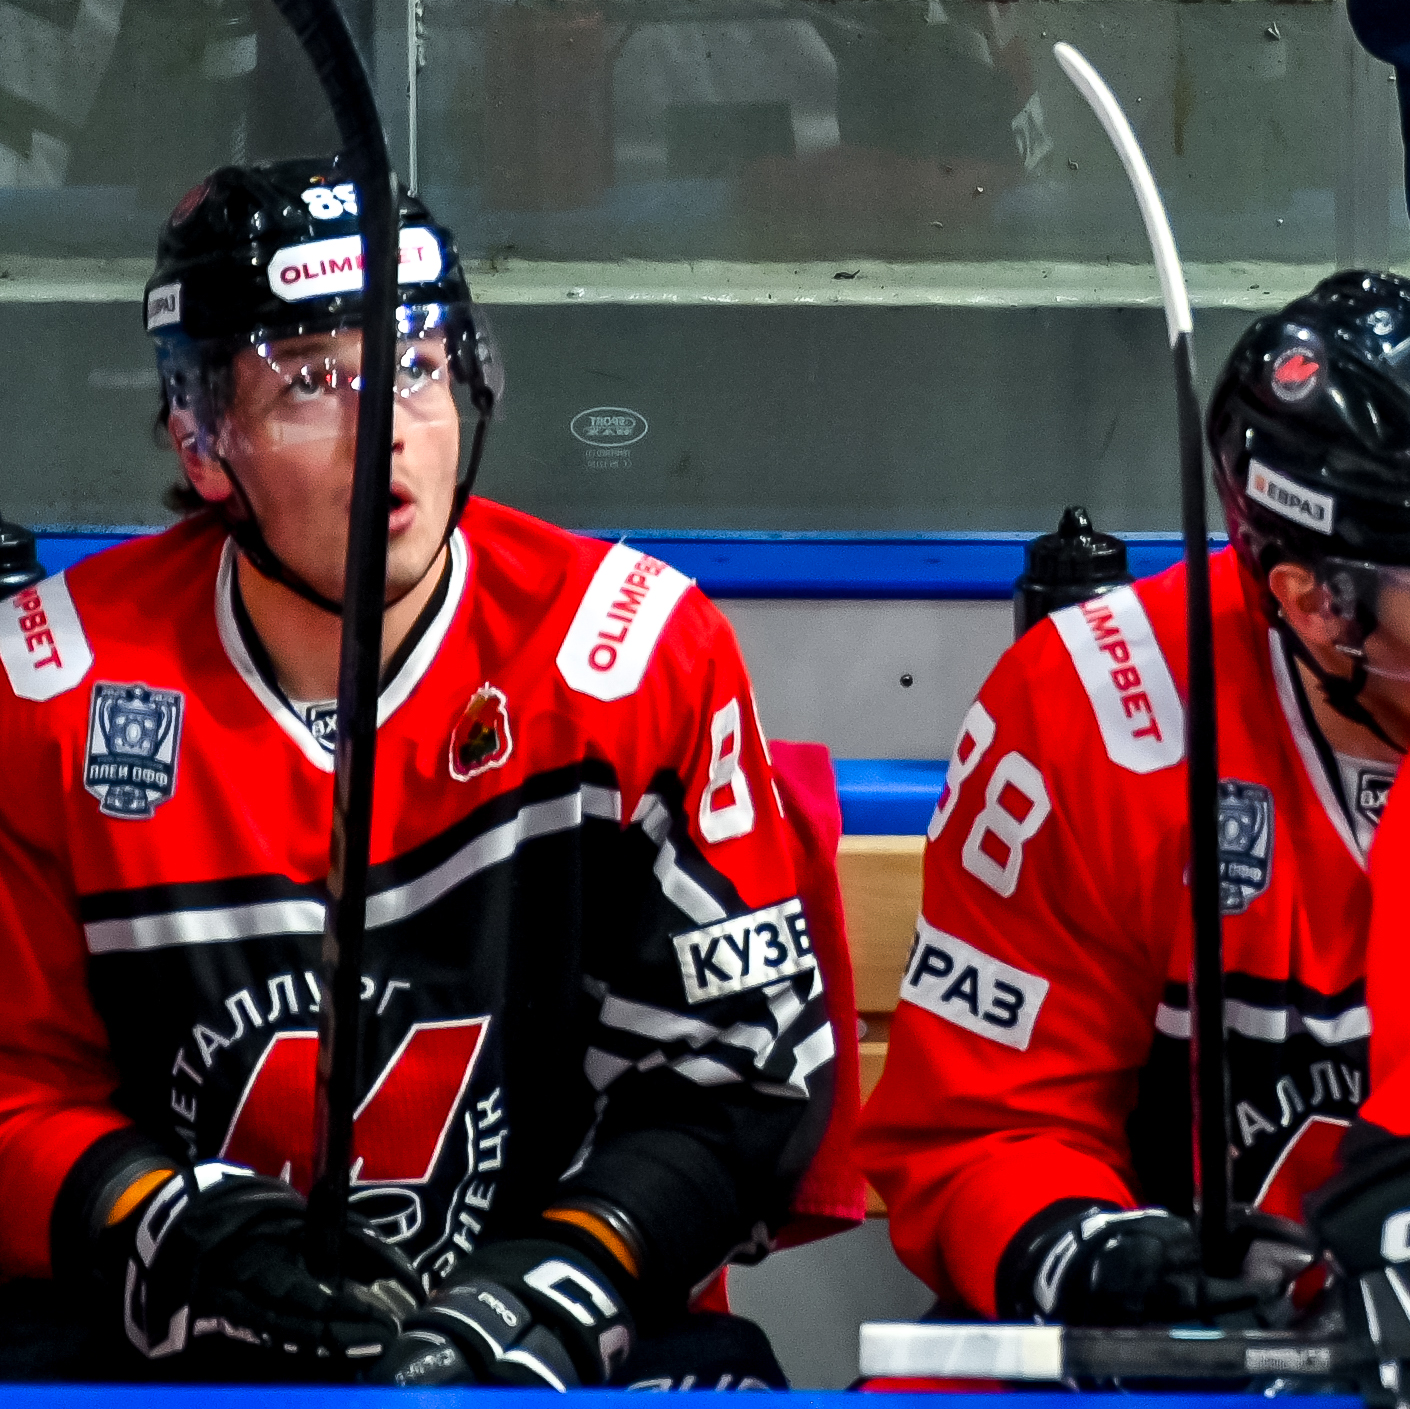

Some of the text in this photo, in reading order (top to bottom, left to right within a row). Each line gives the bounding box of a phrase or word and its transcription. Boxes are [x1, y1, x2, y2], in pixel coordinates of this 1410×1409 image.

[279, 244, 425, 285] OLIMET
[927, 699, 1053, 898] 88
[906, 933, 1025, 1029] РАЗ
